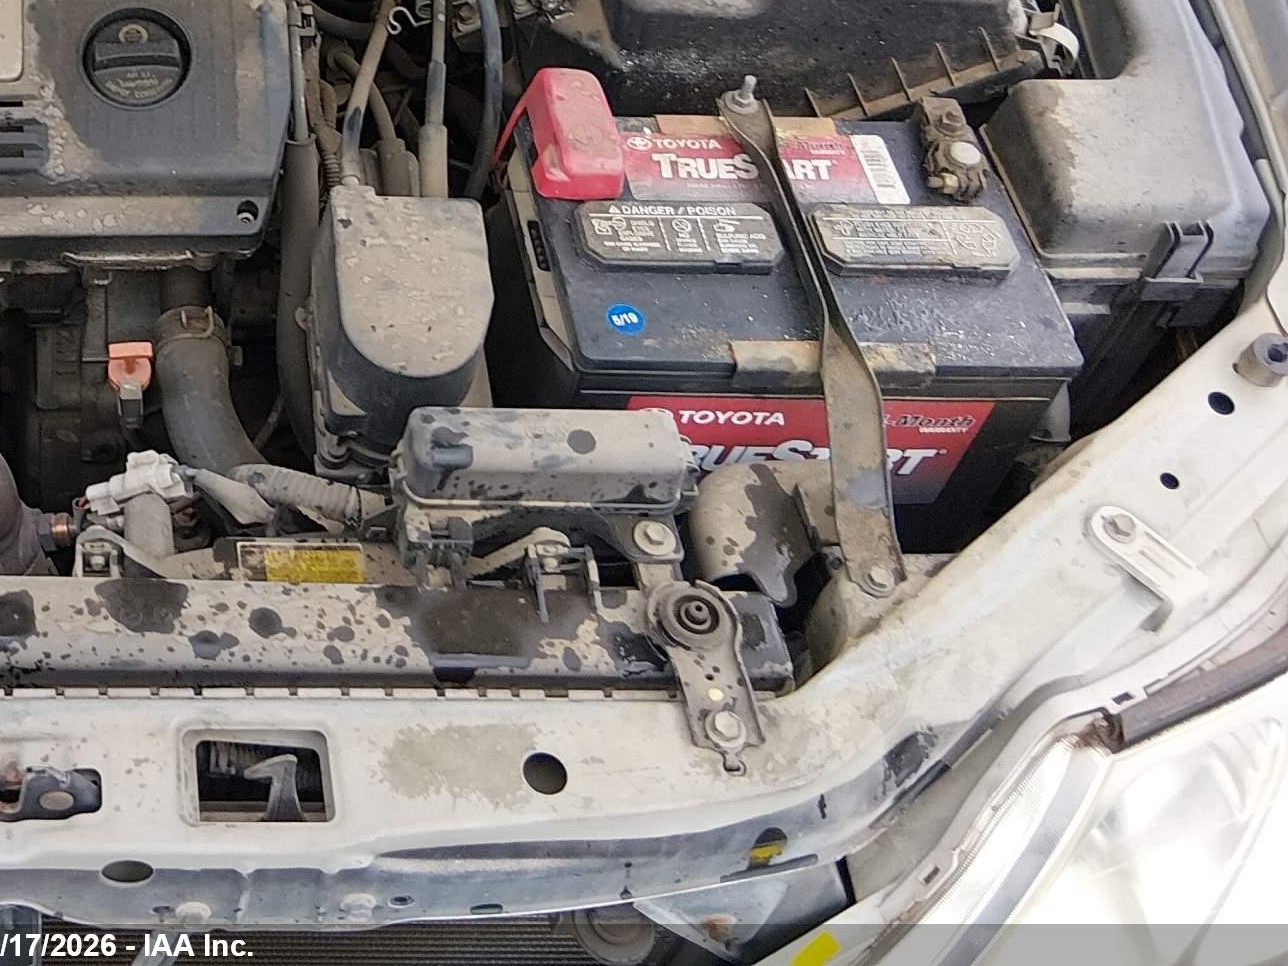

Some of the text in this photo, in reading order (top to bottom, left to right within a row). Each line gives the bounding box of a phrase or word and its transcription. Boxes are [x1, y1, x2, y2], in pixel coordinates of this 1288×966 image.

[652, 137, 723, 150] TOYOTA
[622, 205, 675, 216] DANGER
[687, 206, 737, 216] POISON
[678, 409, 785, 426] TOYOTA
